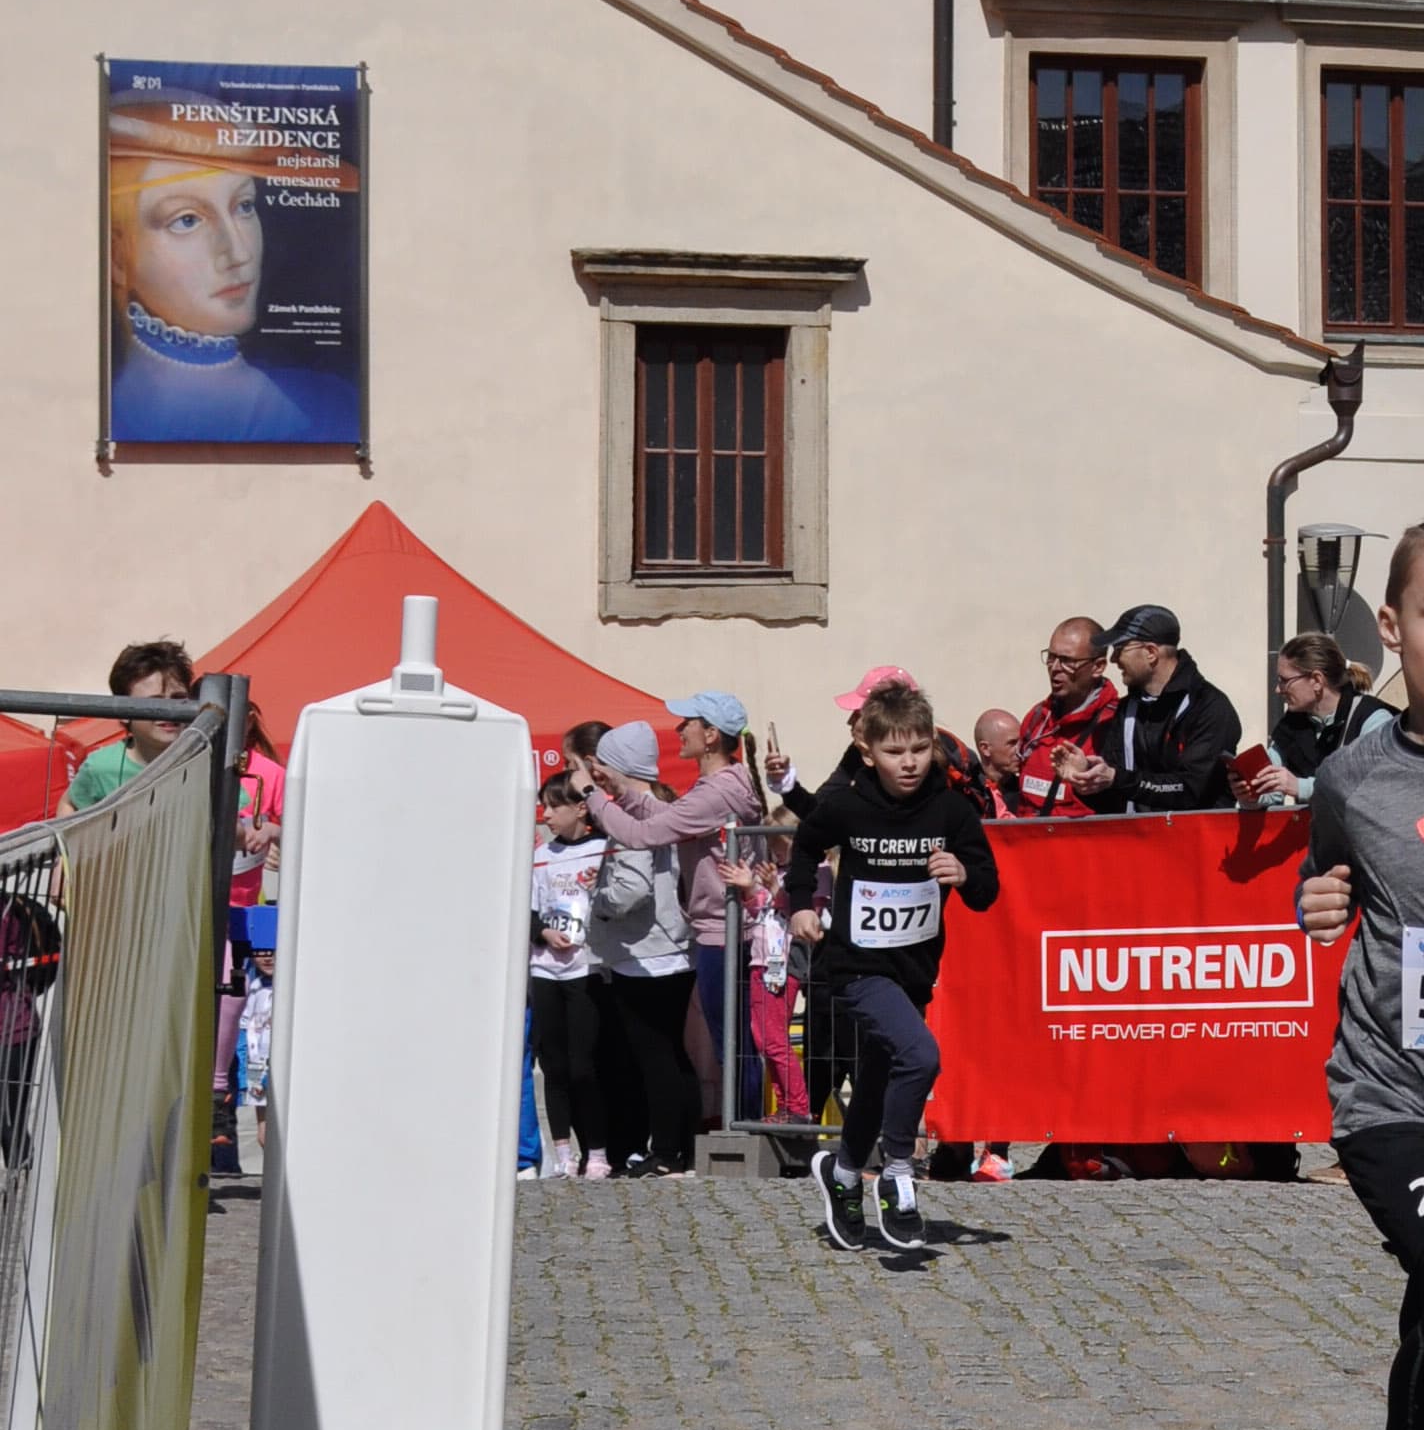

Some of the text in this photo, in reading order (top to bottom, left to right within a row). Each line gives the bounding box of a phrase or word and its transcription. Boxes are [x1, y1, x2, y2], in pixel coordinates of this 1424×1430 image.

[171, 102, 340, 126] PERNŠTEJNSKÁ
[217, 129, 340, 149] REZIDENCE
[277, 154, 340, 170] nejstarší
[267, 176, 340, 188] renesance
[265, 191, 340, 208] v Čechách
[879, 838, 918, 855] CREW
[898, 858, 928, 867] TOGETHE
[860, 902, 932, 932] 2077
[1058, 942, 1297, 992] NUTREND
[1048, 1021, 1309, 1041] THE POWER OF NUTRITION
